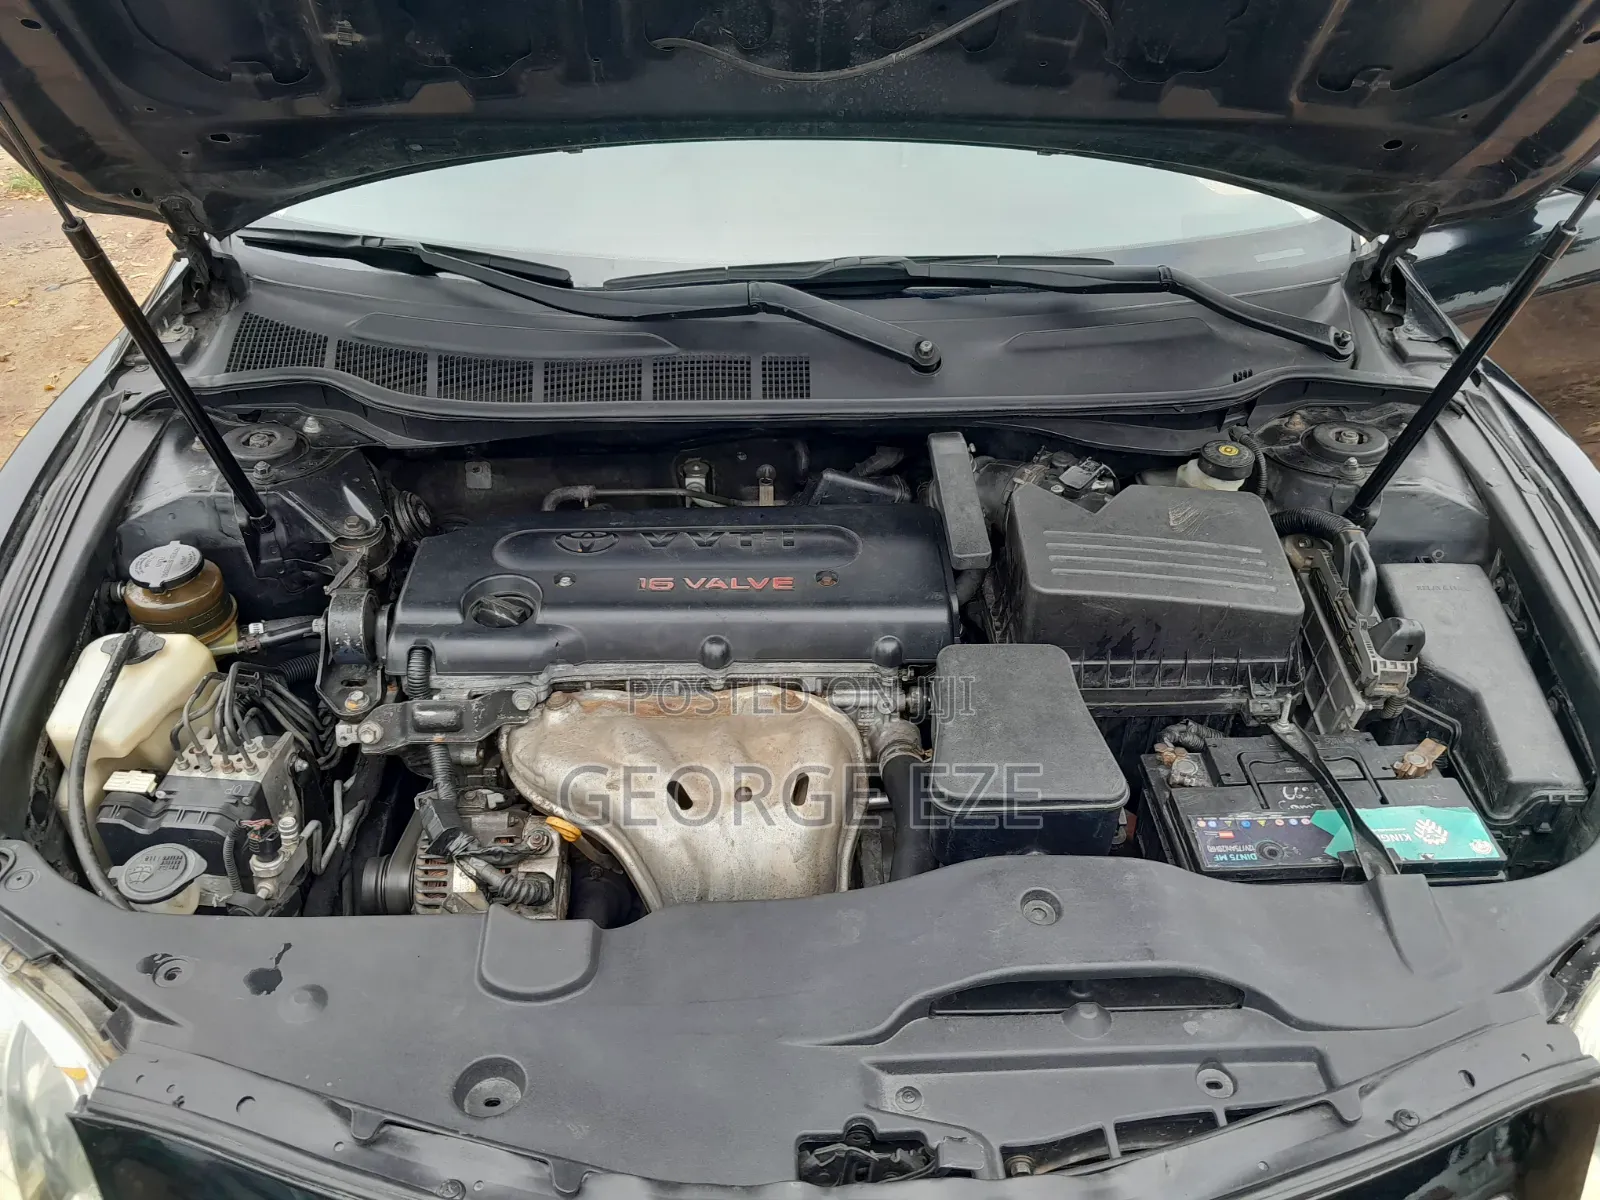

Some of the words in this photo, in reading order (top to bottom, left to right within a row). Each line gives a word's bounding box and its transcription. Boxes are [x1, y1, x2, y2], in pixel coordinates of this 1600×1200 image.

[638, 577, 675, 591] 16
[683, 576, 795, 591] VALVE
[1214, 853, 1228, 861] MF
[1229, 853, 1258, 861] DIN75
